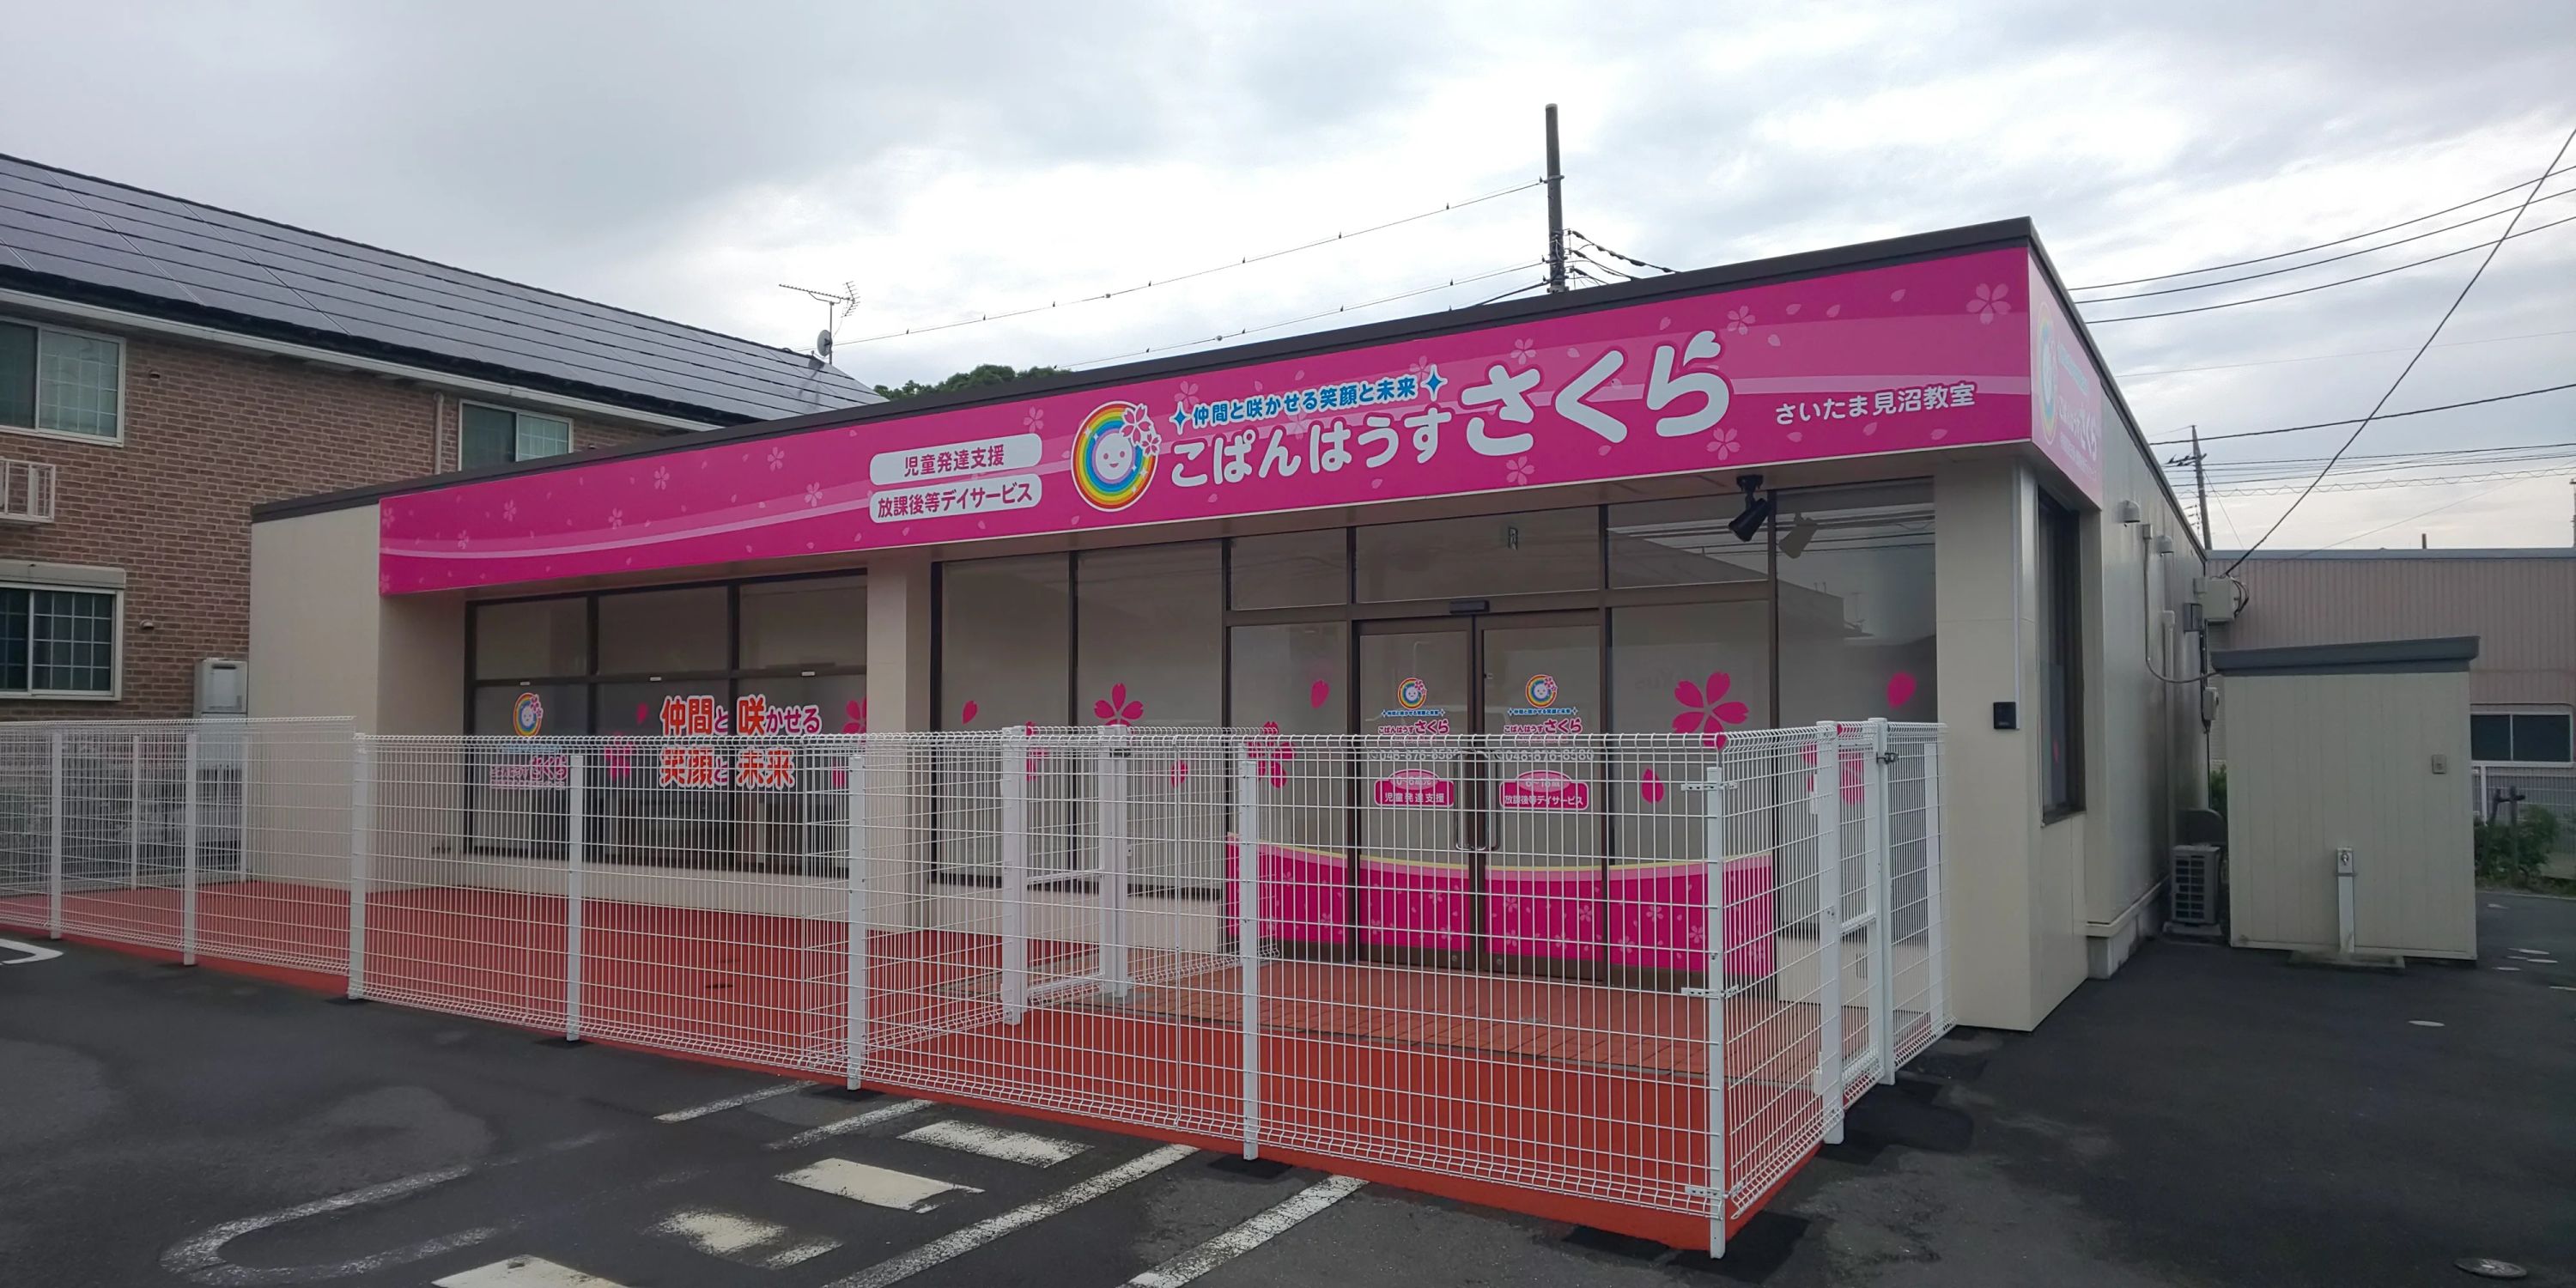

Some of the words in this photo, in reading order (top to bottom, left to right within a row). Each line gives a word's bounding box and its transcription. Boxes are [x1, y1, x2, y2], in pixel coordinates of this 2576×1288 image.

[1192, 372, 1418, 428] 仲間と咲かせる笑顔と未来
[1775, 382, 1976, 426] さいたま見沼教室
[903, 444, 1005, 477] 児童発達支援
[877, 481, 1033, 519] 放課後等デイサービス
